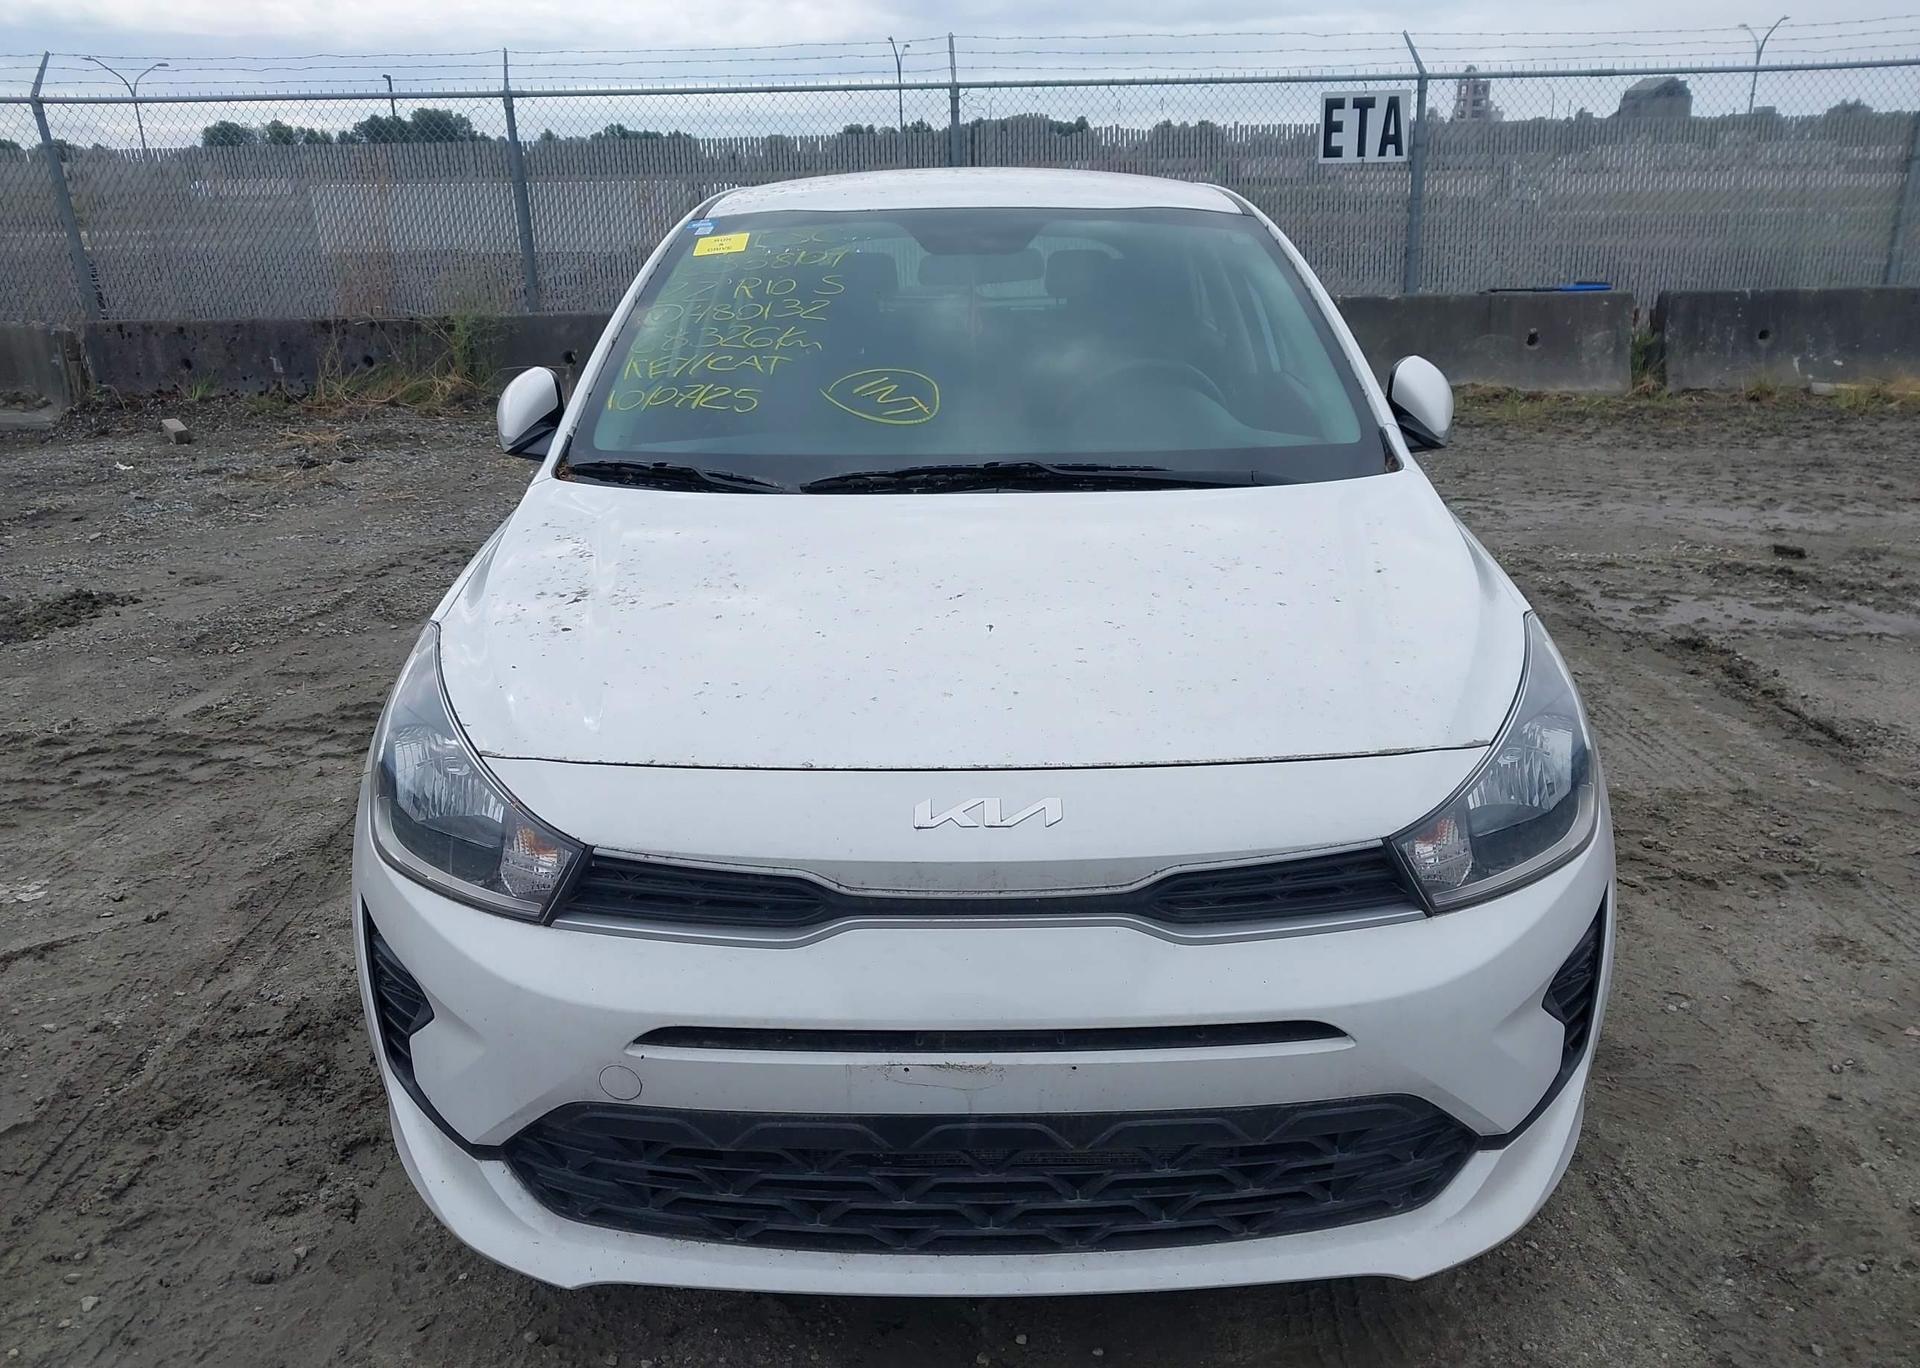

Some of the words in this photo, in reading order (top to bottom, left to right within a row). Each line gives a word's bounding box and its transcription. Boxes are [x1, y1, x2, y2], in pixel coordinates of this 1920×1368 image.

[1323, 96, 1404, 158] ETA
[733, 277, 797, 299] RIO
[813, 274, 847, 295] S
[913, 797, 1064, 829] KIA
